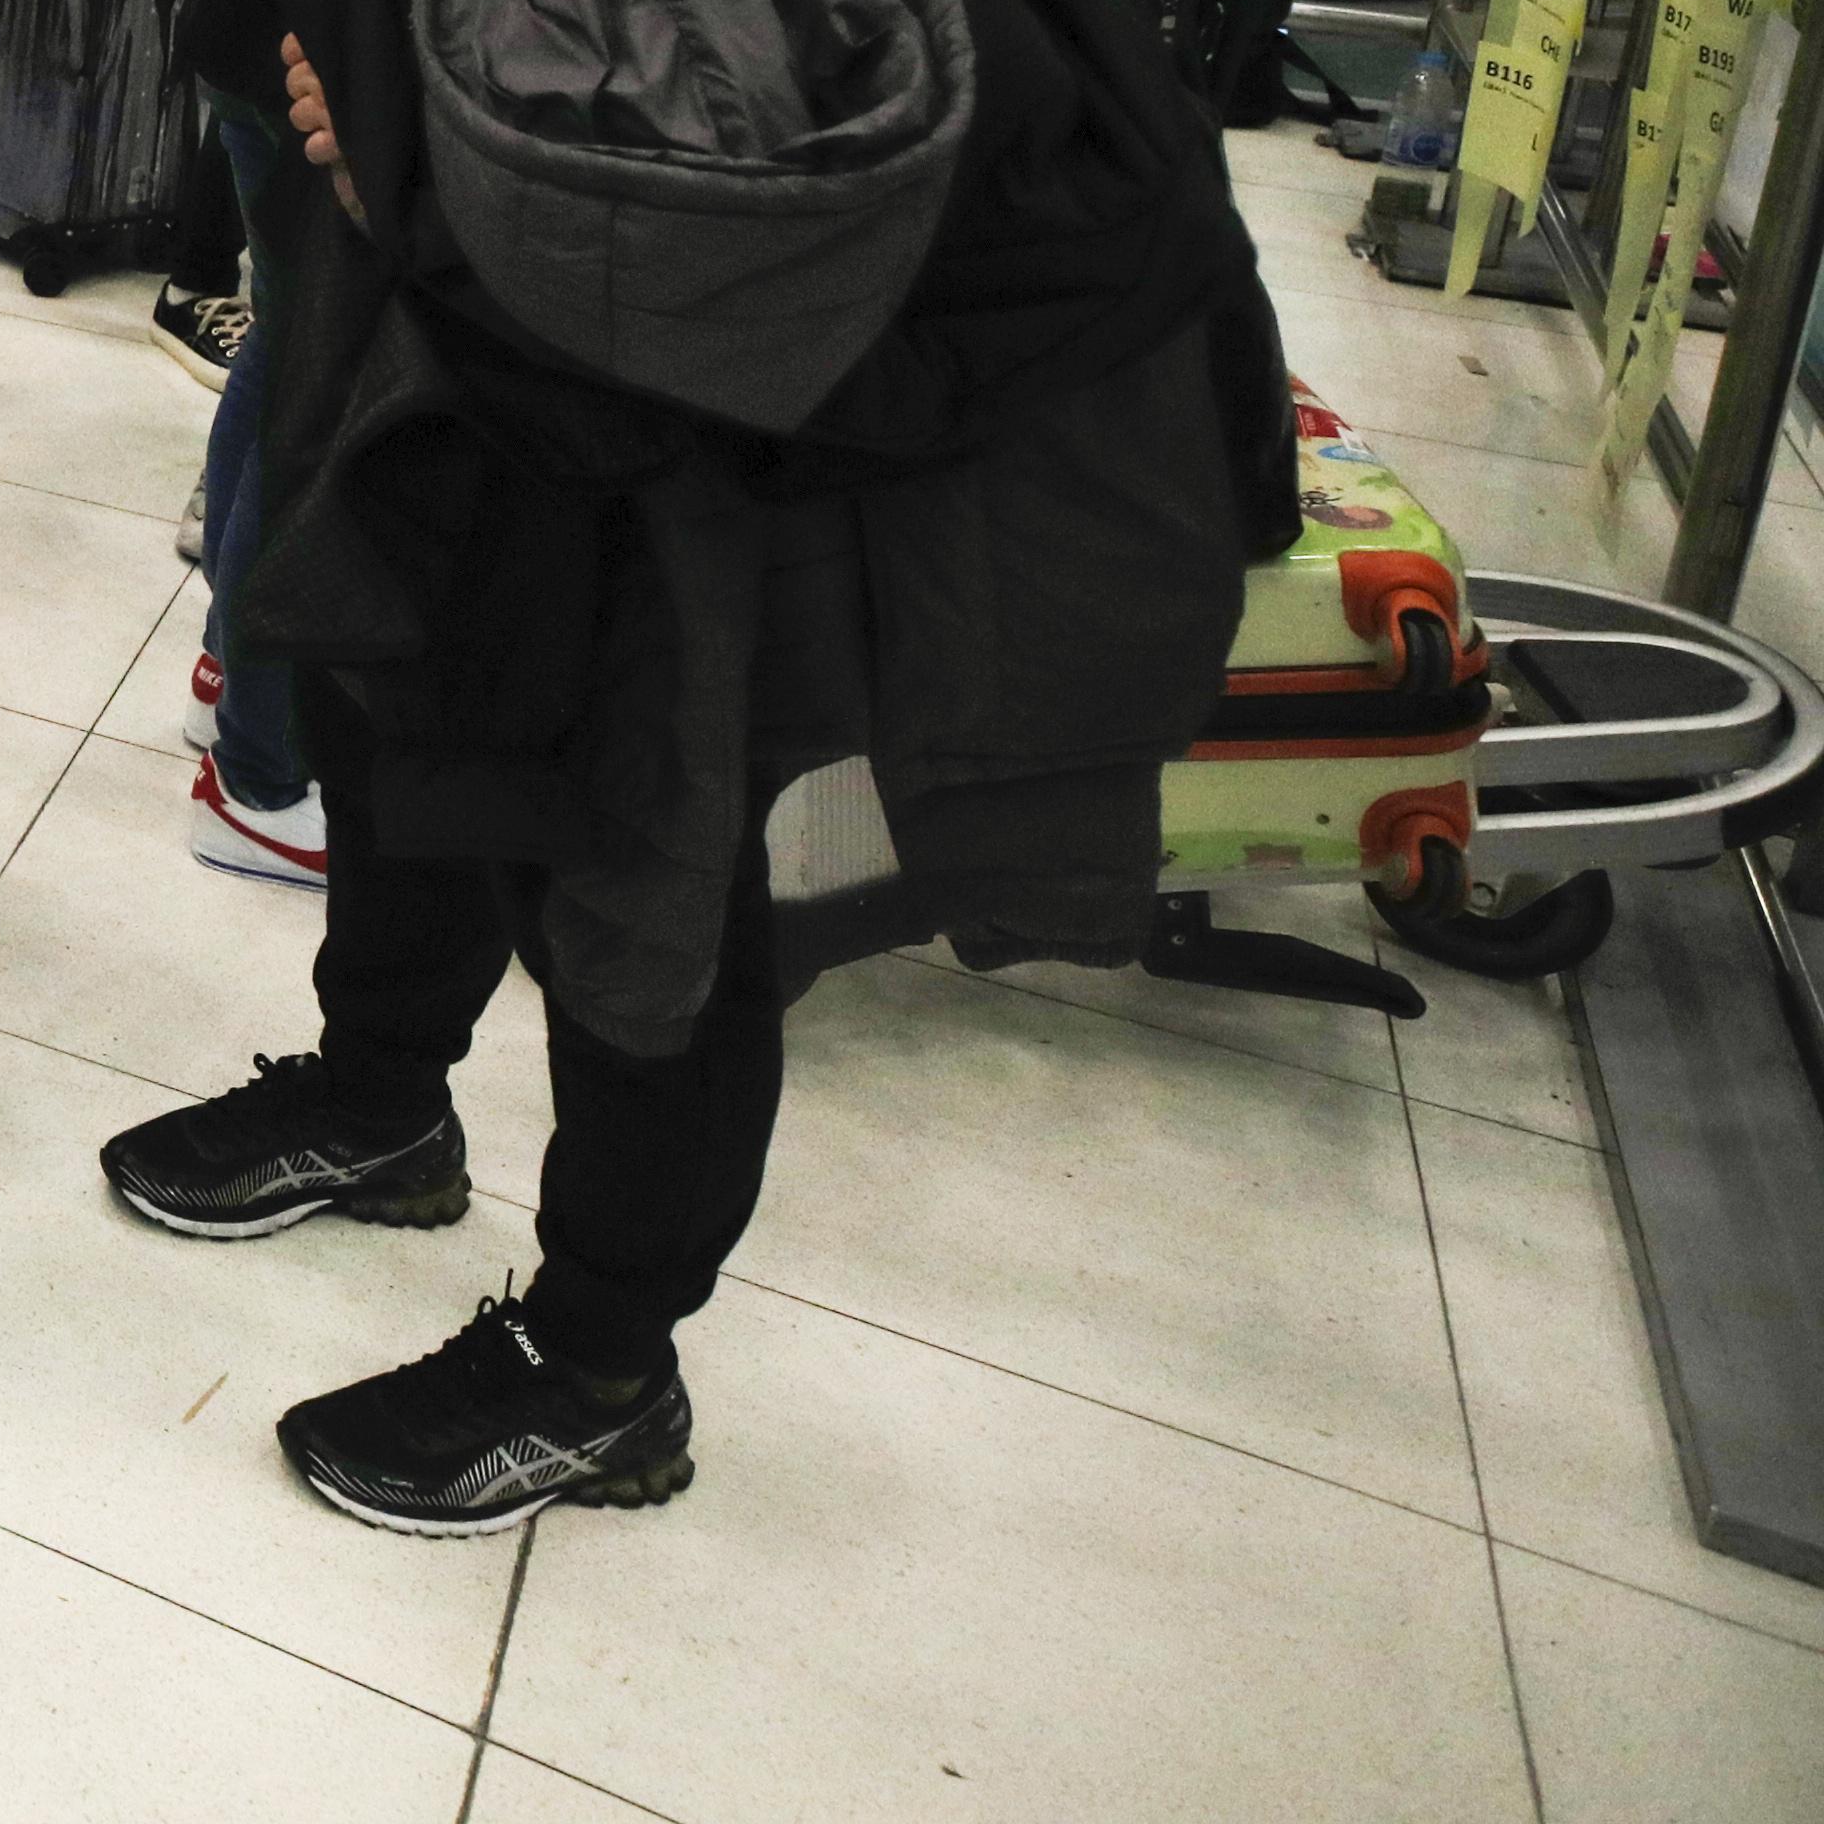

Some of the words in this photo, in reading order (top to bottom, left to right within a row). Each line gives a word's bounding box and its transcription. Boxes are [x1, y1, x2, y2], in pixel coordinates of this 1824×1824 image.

[1485, 60, 1534, 91] B116
[197, 665, 224, 689] NIKE
[514, 1332, 545, 1367] asics
